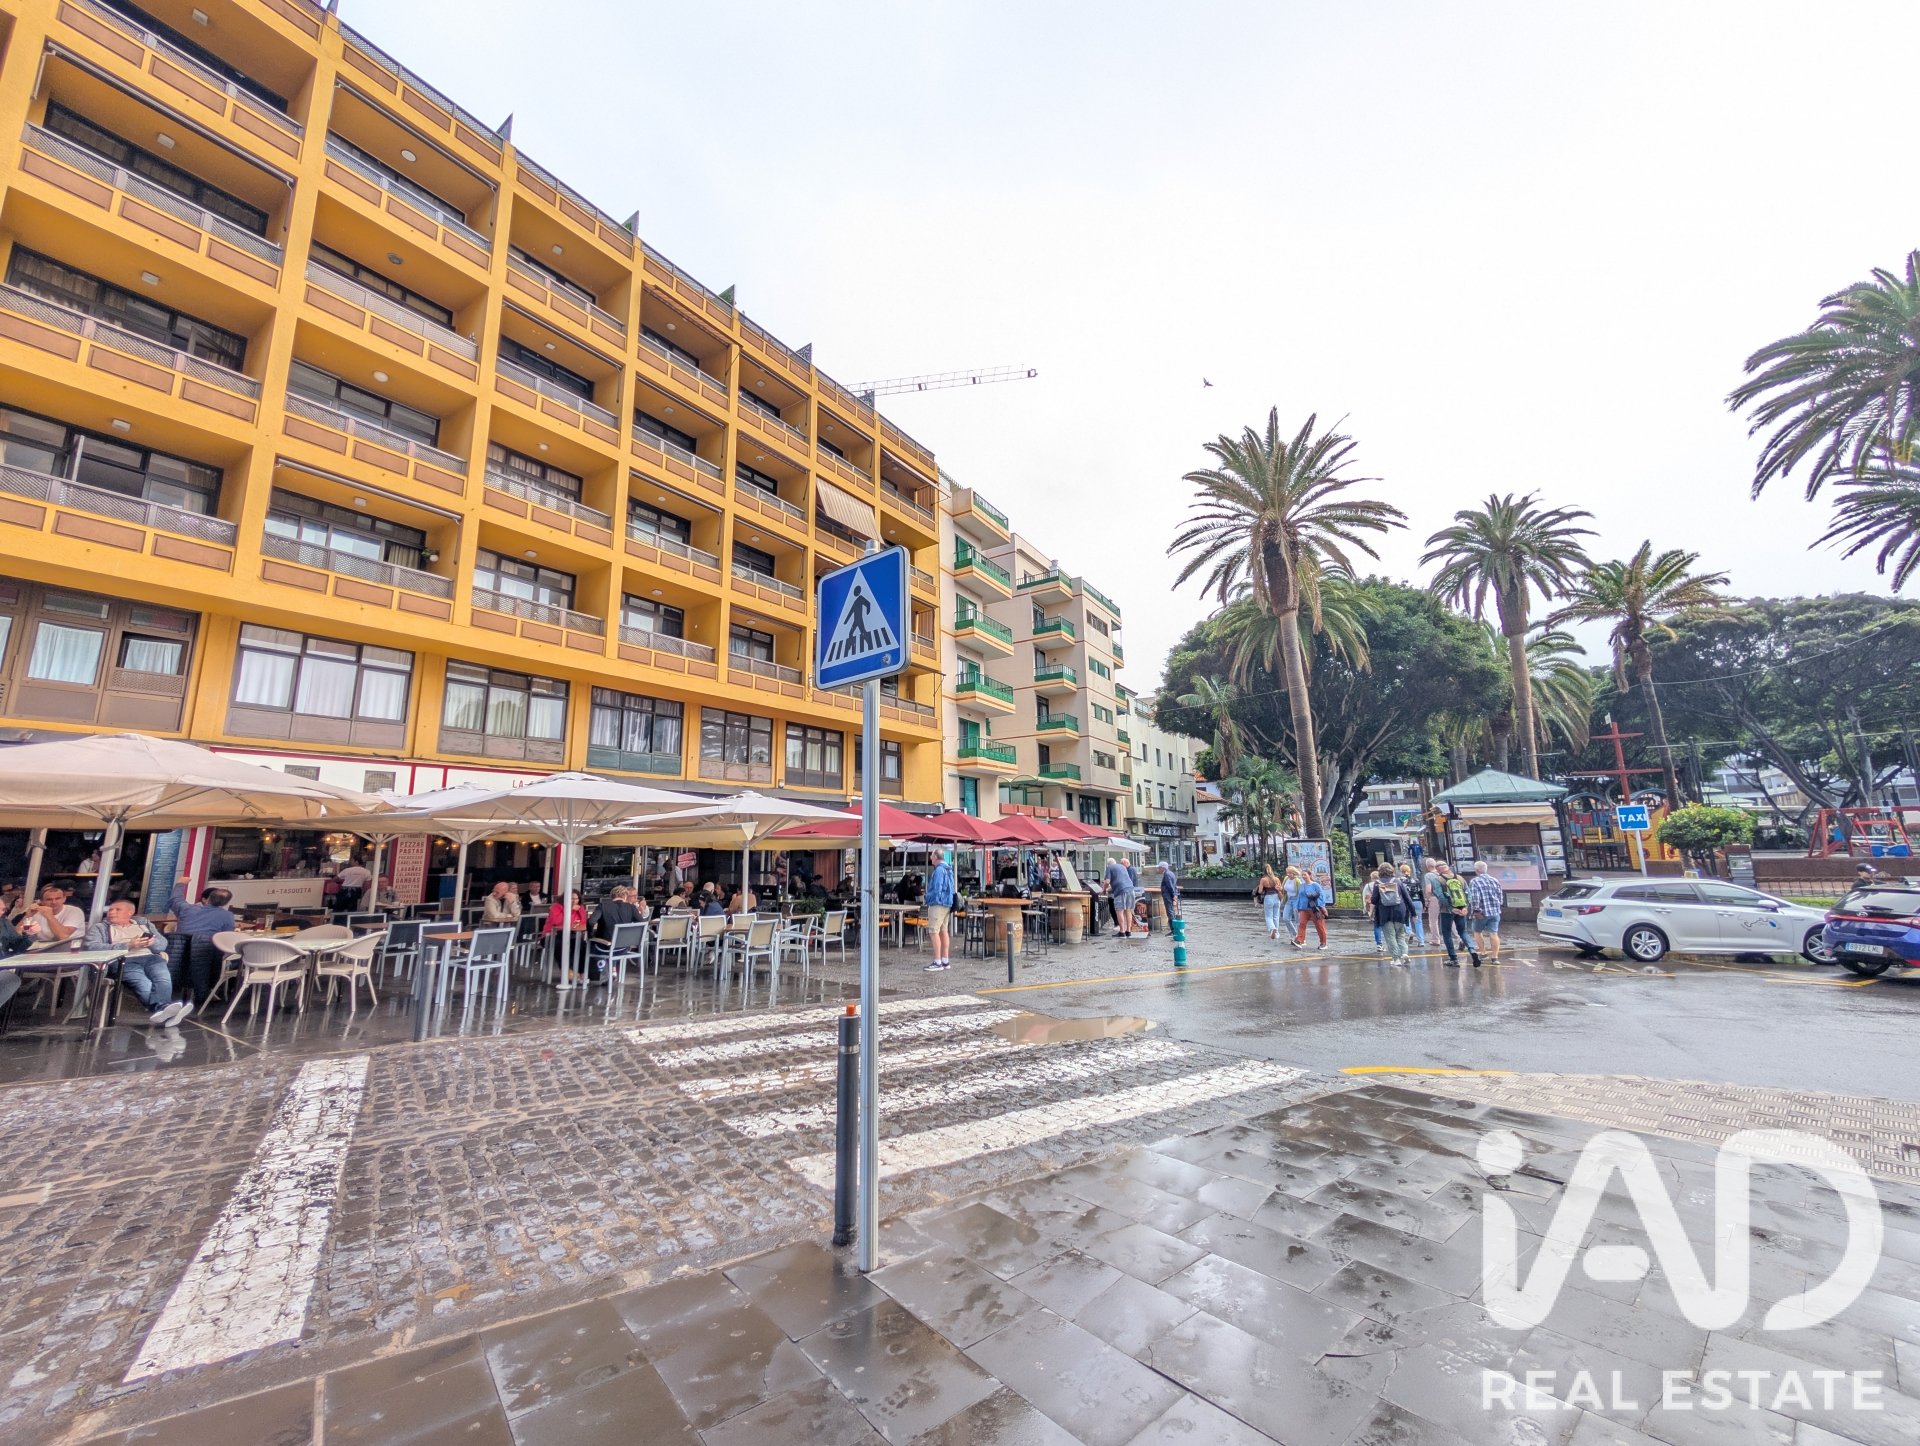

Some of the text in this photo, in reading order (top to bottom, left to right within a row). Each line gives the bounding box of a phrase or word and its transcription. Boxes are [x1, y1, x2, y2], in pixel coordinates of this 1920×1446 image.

[1619, 813, 1647, 822] TAXI
[1148, 828, 1172, 836] PLAZA
[266, 887, 312, 895] LA-TASQUITA
